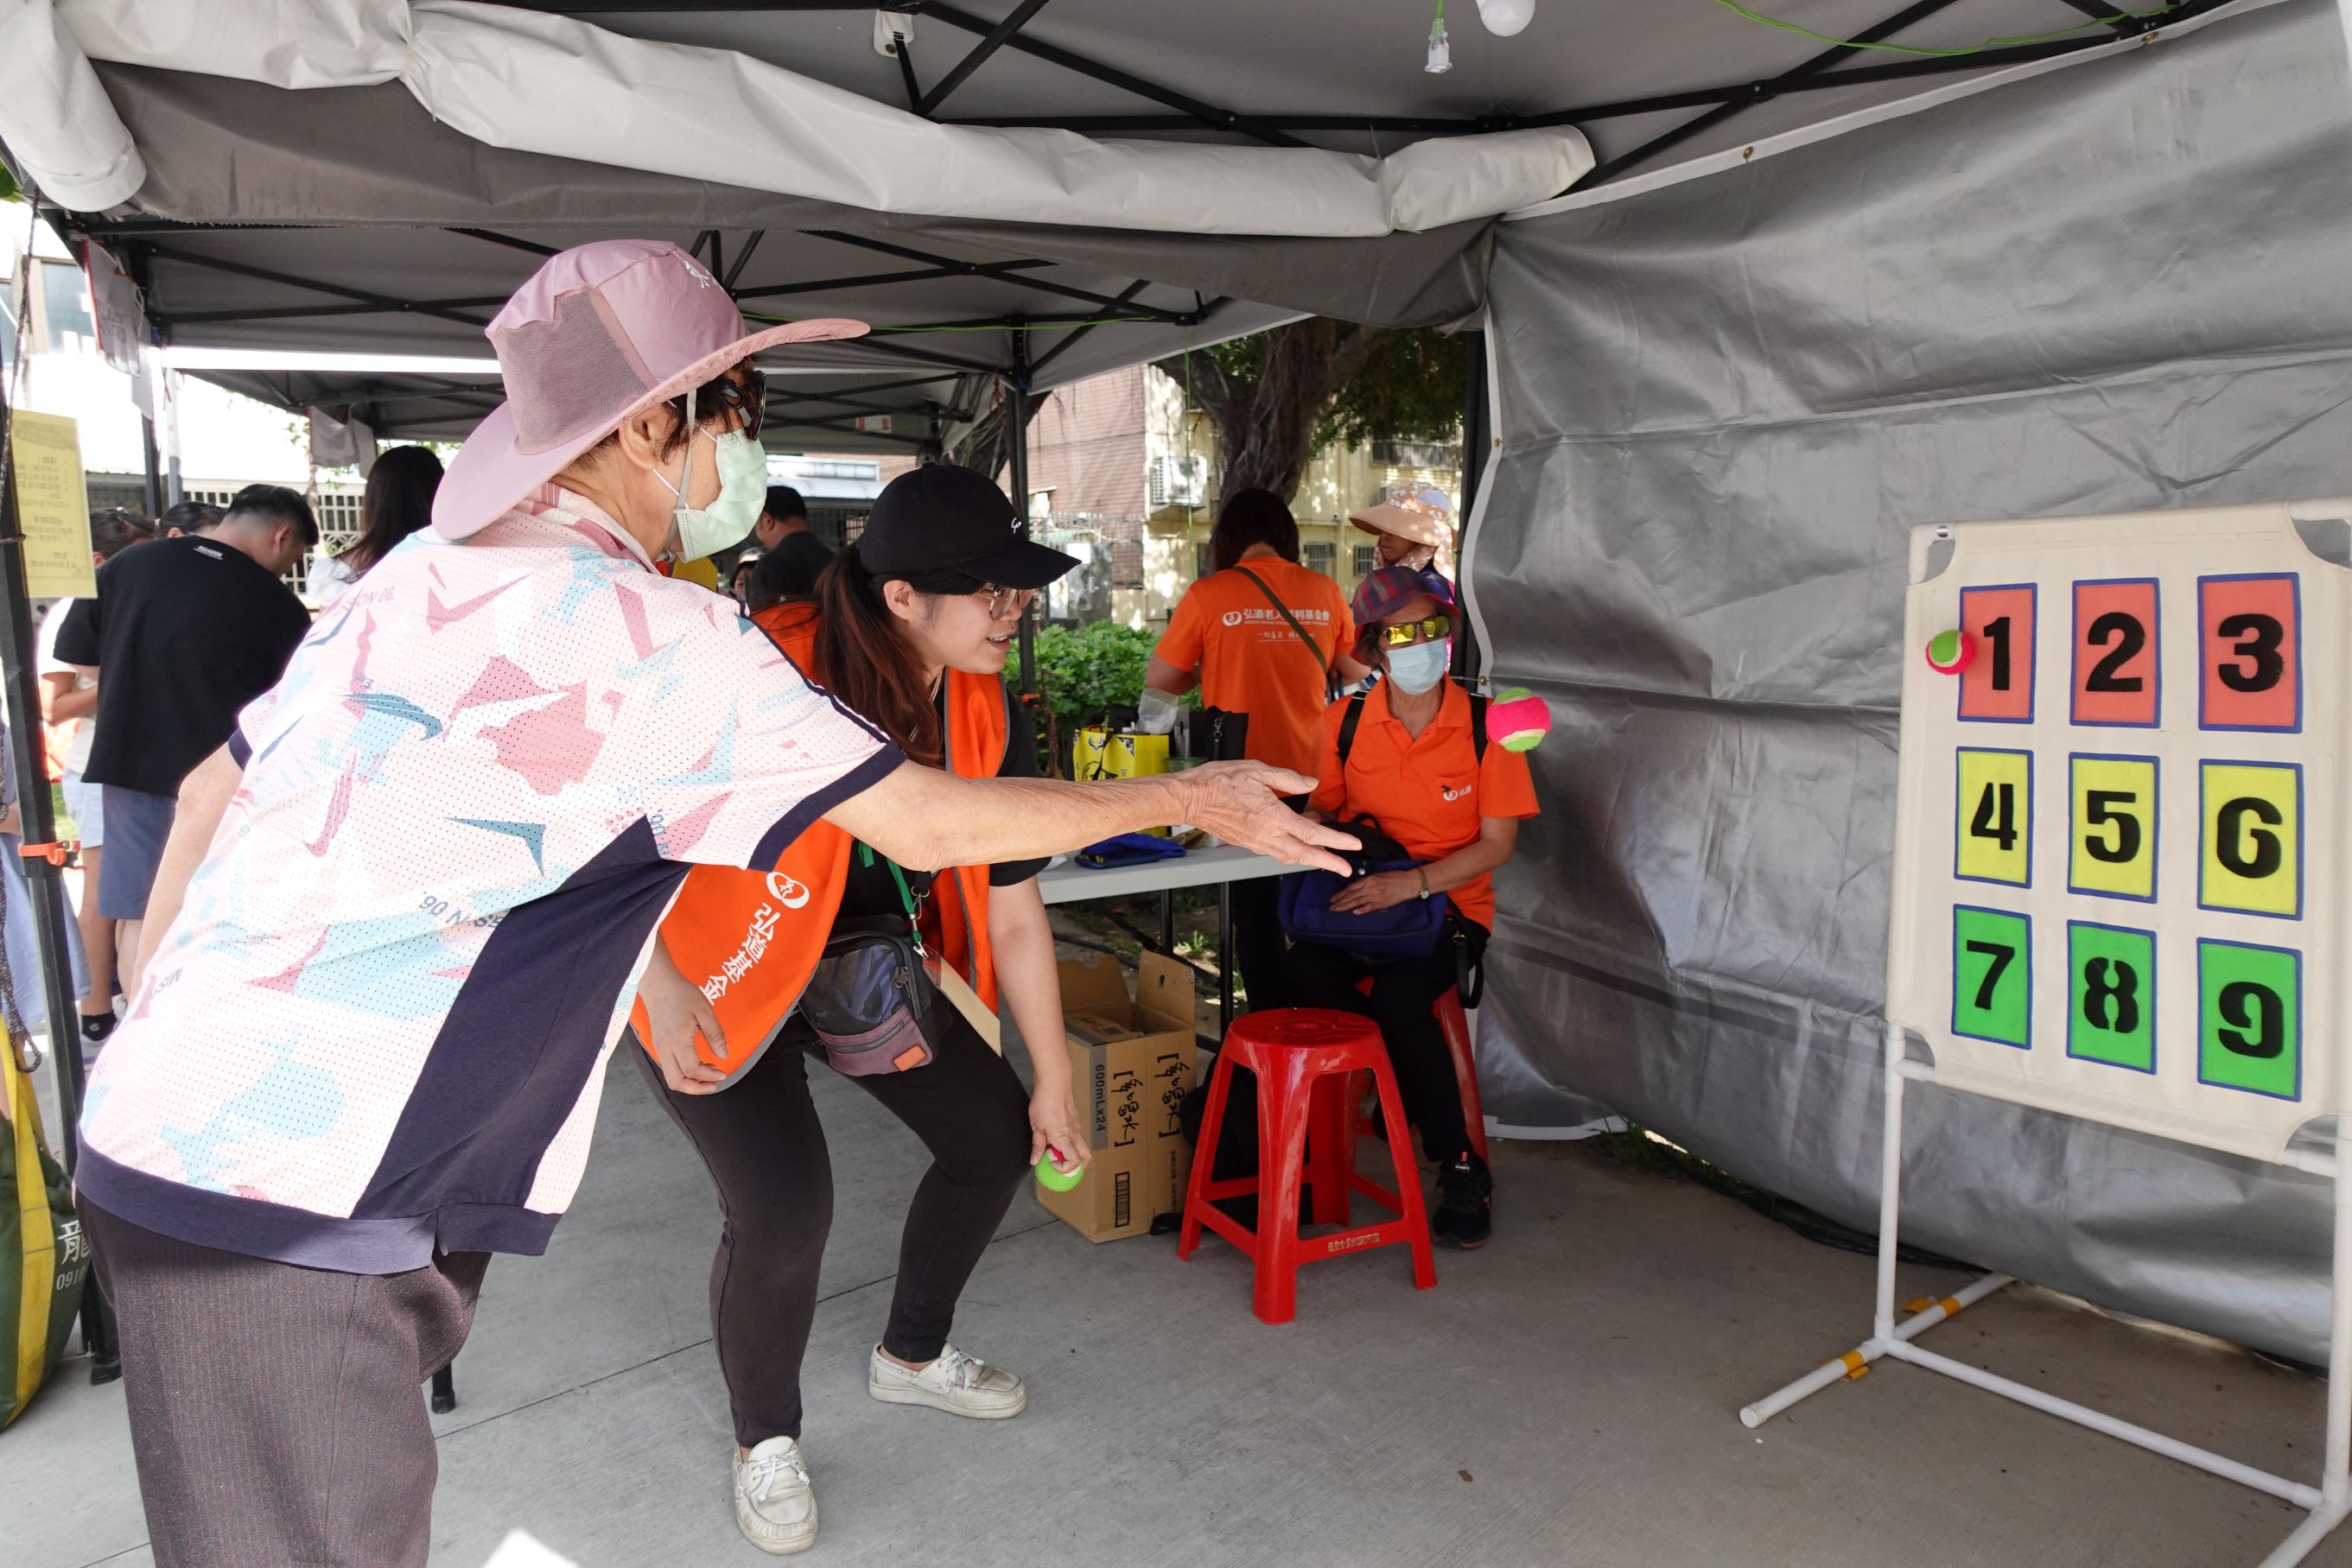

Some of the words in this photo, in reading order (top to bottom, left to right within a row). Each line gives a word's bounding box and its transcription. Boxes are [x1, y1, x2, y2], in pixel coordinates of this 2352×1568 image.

[1983, 616, 2011, 691] 1
[2085, 612, 2145, 693] 2
[2217, 613, 2284, 693] 3
[1970, 782, 2018, 851] 4
[2085, 790, 2140, 863] 5
[2216, 797, 2281, 879] 6
[698, 902, 781, 1006] 弘道基金
[1967, 939, 2015, 1011] 7
[2083, 956, 2139, 1035] 8
[2217, 981, 2284, 1059] 9
